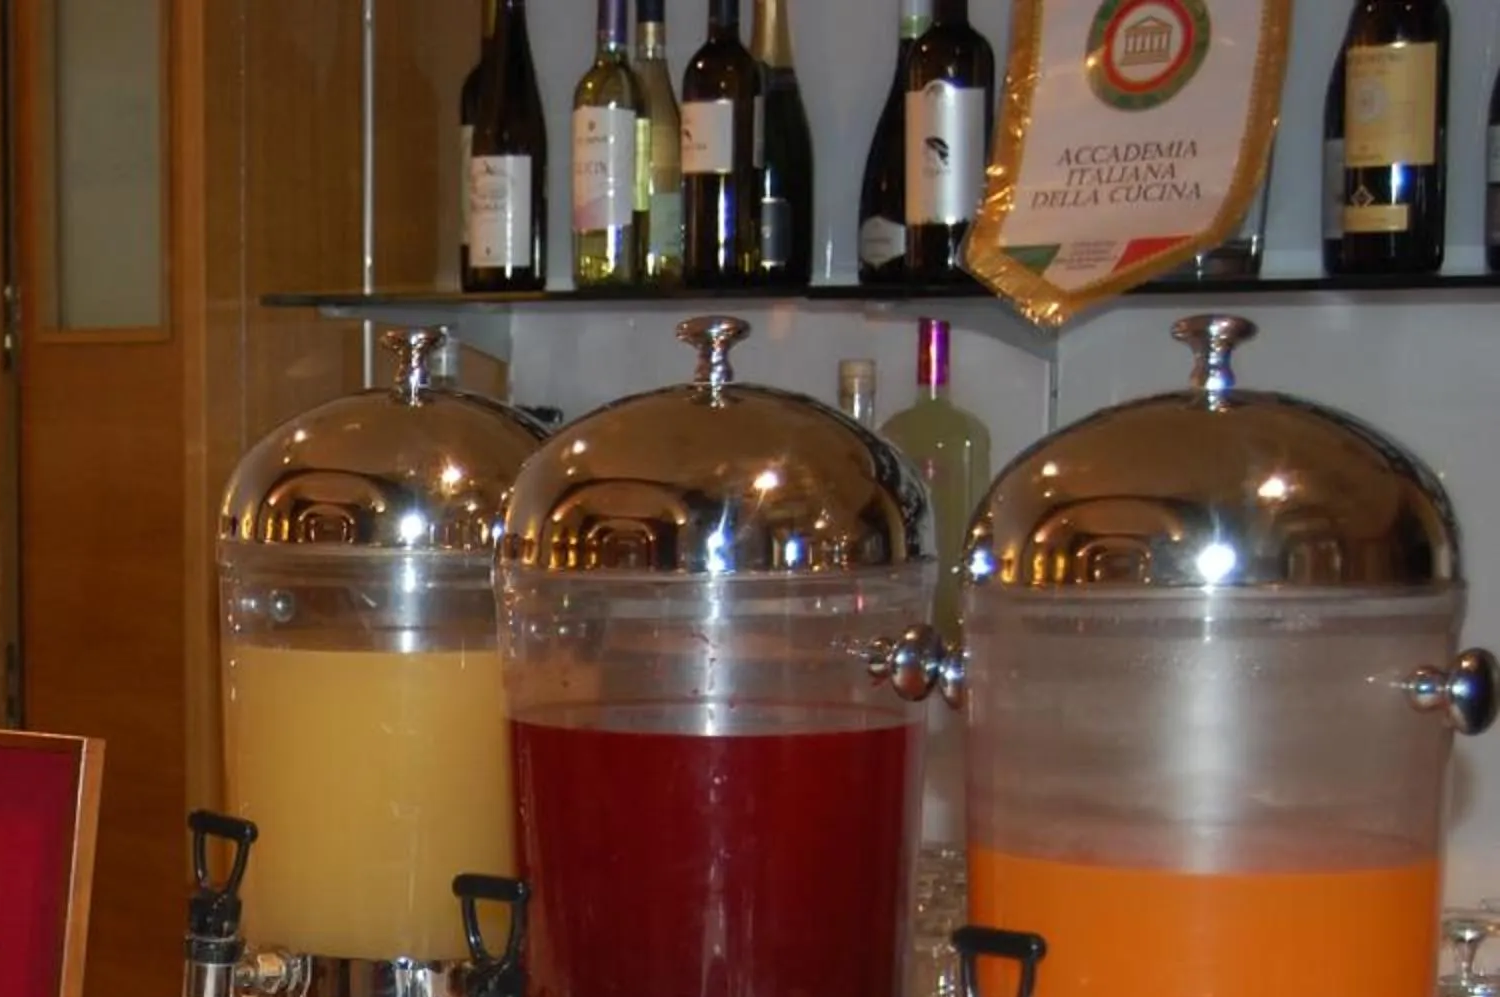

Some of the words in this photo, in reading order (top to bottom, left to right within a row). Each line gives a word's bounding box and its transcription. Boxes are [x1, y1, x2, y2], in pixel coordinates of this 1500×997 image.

[1055, 139, 1198, 167] ACCADEMIA
[1065, 162, 1177, 187] ITALIANA
[1030, 188, 1099, 210] DELLA
[1108, 182, 1202, 205] CUCINA
